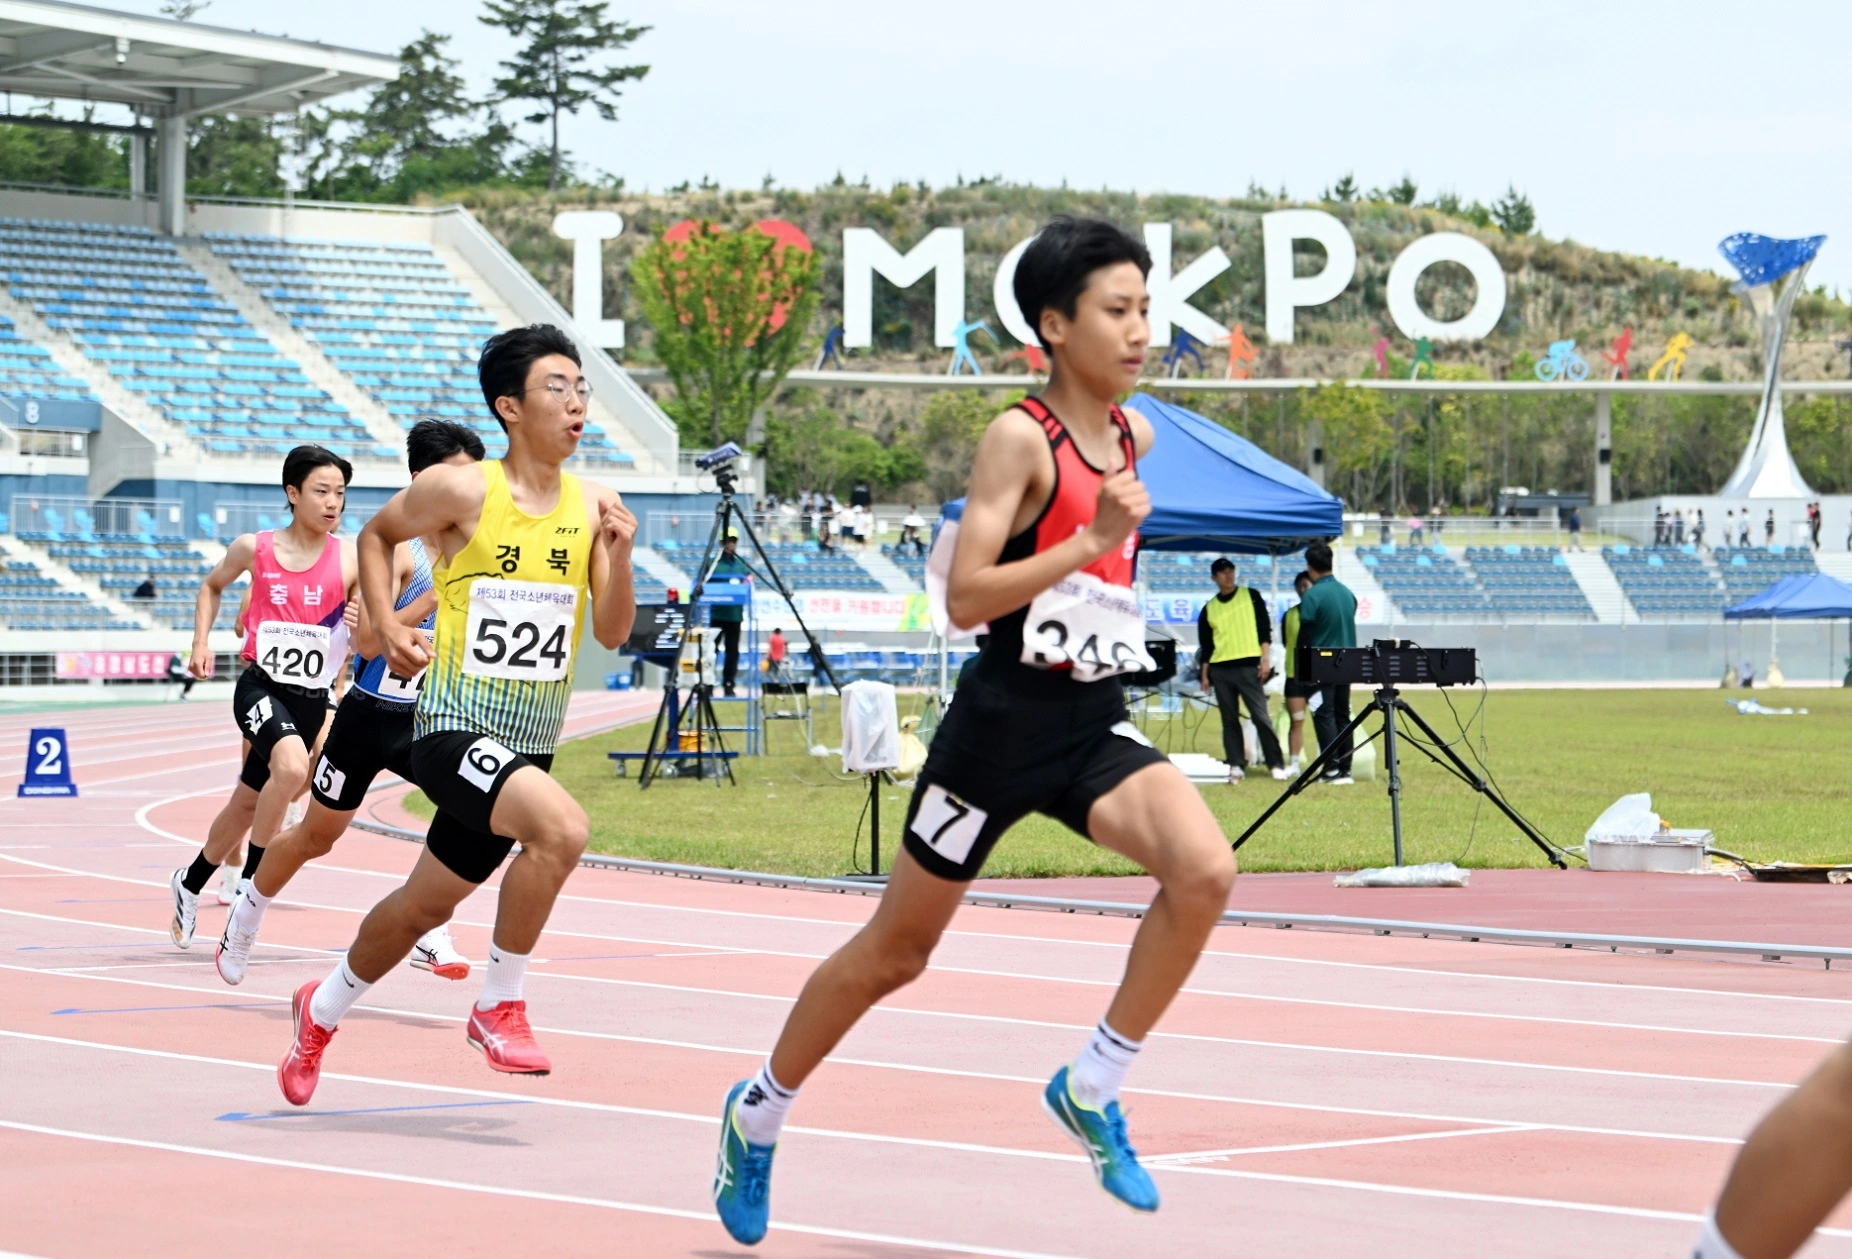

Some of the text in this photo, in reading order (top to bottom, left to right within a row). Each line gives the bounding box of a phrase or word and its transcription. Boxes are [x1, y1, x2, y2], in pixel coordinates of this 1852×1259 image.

[553, 211, 625, 348] I
[476, 587, 574, 605] 제53회 전국소년체육대회
[473, 618, 566, 669] 524
[261, 646, 324, 679] 420
[255, 703, 264, 725] 4
[35, 737, 62, 775] 2
[467, 747, 500, 776] 6
[319, 762, 337, 793] 5
[929, 794, 970, 846] 7
